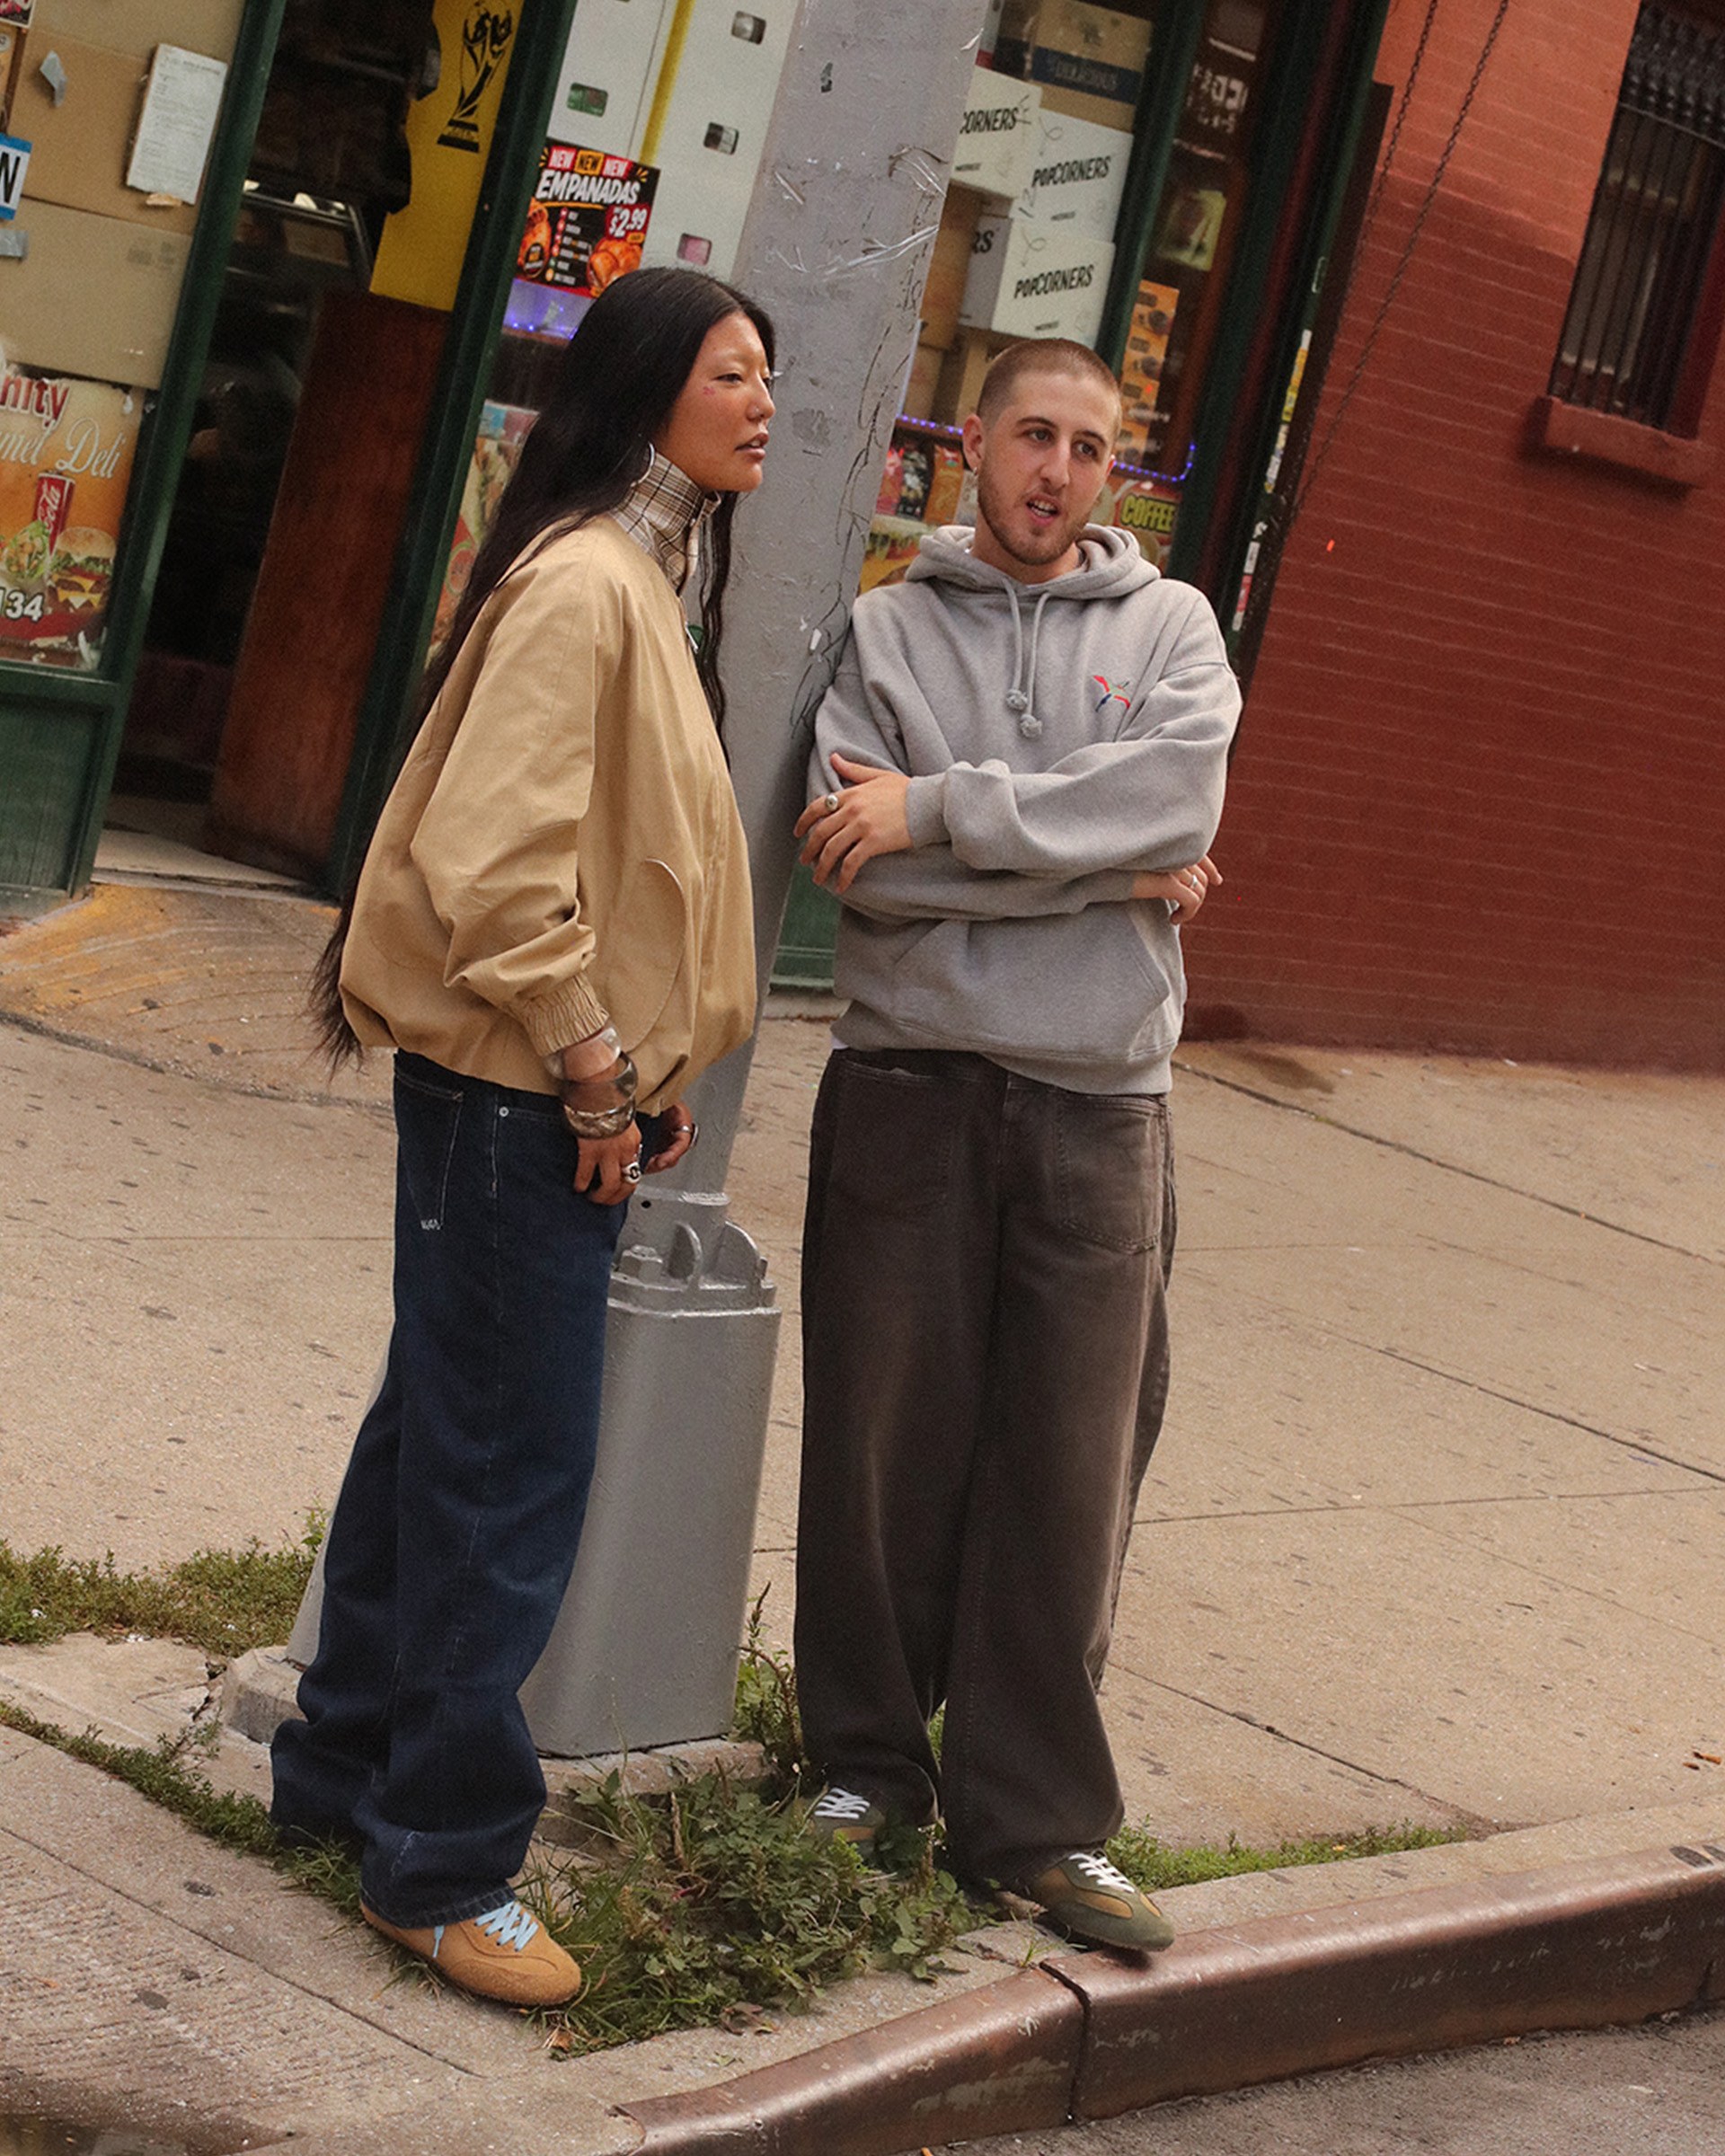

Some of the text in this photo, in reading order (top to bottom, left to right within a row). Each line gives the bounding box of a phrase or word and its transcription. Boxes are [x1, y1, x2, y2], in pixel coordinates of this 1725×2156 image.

[548, 149, 628, 178] NEW NEW NEW
[1031, 155, 1112, 188] POPCORNERS
[535, 168, 641, 205] EMPANADAS
[608, 208, 648, 237] $2.99
[1013, 264, 1095, 299] POPCORNERS
[55, 416, 126, 479] Deli
[1120, 493, 1176, 533] COFFEE
